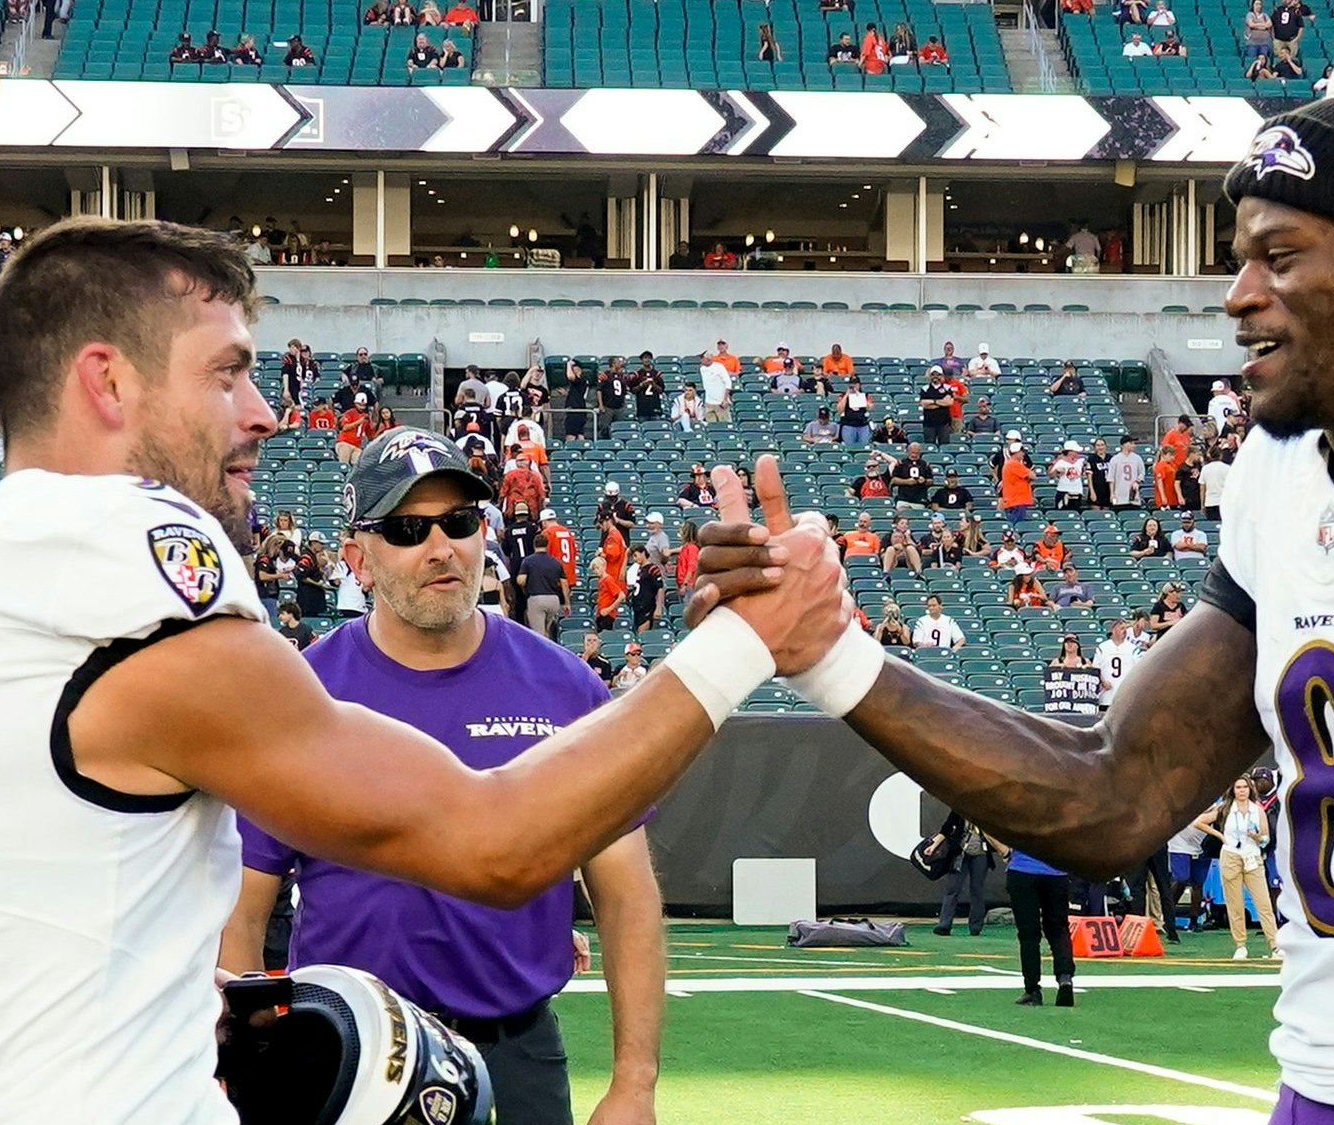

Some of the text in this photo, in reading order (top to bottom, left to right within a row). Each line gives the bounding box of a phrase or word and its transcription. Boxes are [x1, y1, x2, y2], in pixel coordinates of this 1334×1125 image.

[1281, 11, 1289, 24] 9
[613, 380, 622, 396] 9
[1123, 465, 1133, 481] 9
[153, 526, 210, 546] RAVENS
[516, 537, 526, 557] 1
[560, 538, 570, 562] 9
[931, 630, 941, 646] 9
[1111, 657, 1122, 678] 9
[1045, 702, 1058, 711] FOR
[1085, 920, 1121, 952] 30
